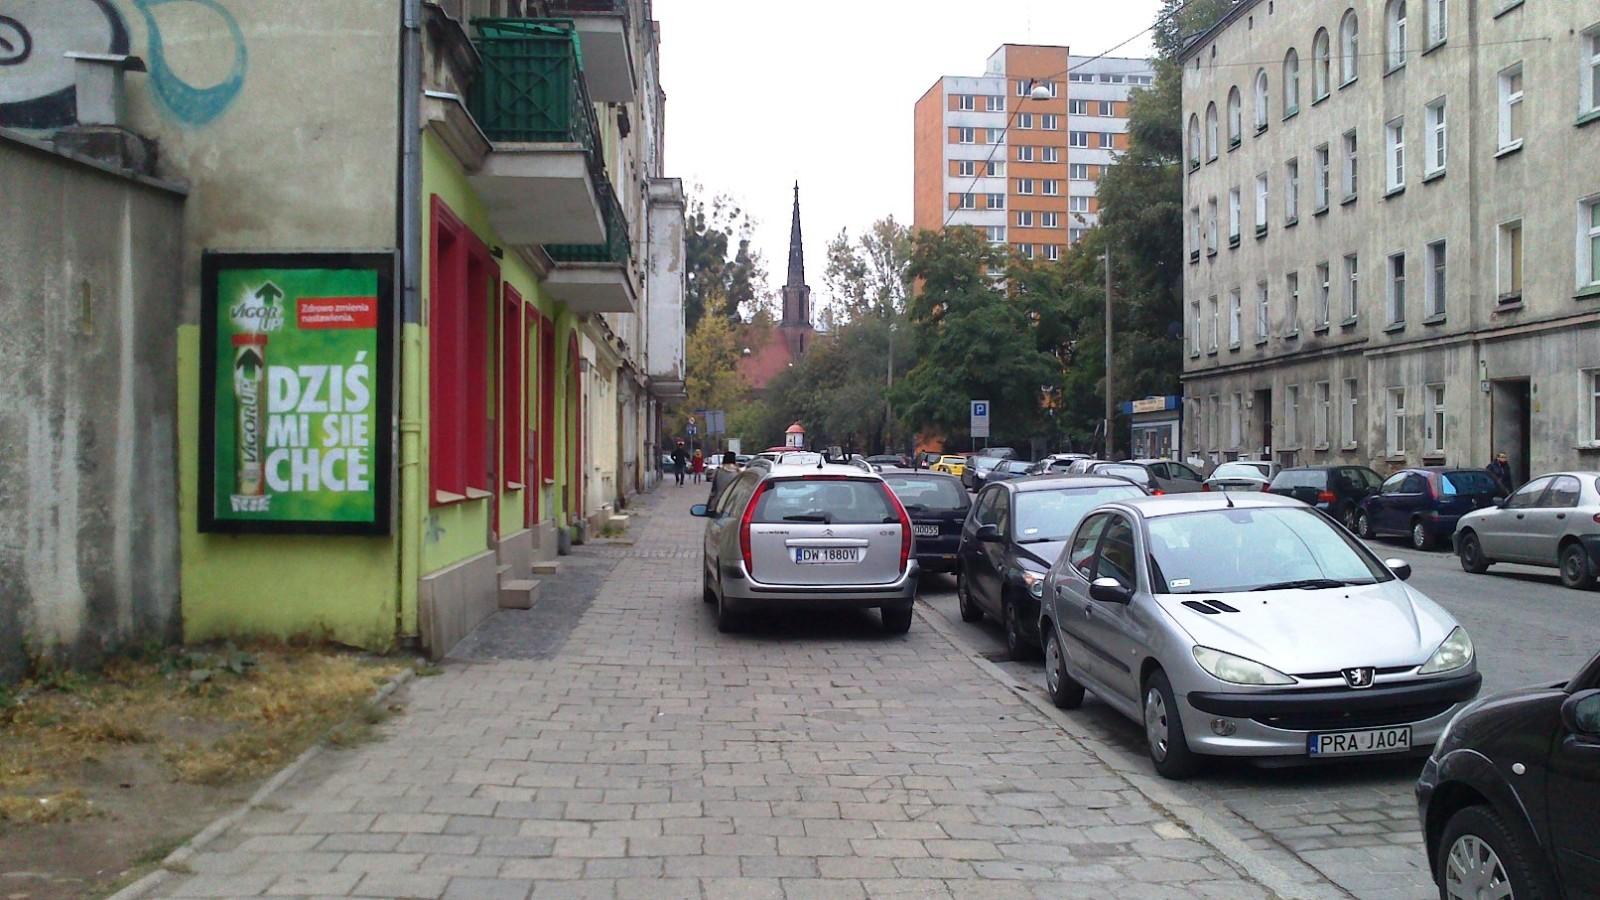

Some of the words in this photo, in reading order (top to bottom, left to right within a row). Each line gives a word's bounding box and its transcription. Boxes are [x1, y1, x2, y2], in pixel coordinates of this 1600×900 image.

[231, 303, 278, 319] VIGOR
[335, 303, 369, 312] zmienia
[267, 350, 370, 413] DZIŚ
[266, 413, 310, 448] MI
[264, 447, 369, 492] CHCE
[803, 549, 819, 561] DW
[824, 549, 856, 560] 1880V
[1320, 733, 1359, 753] PRA
[1366, 728, 1408, 750] JA04
